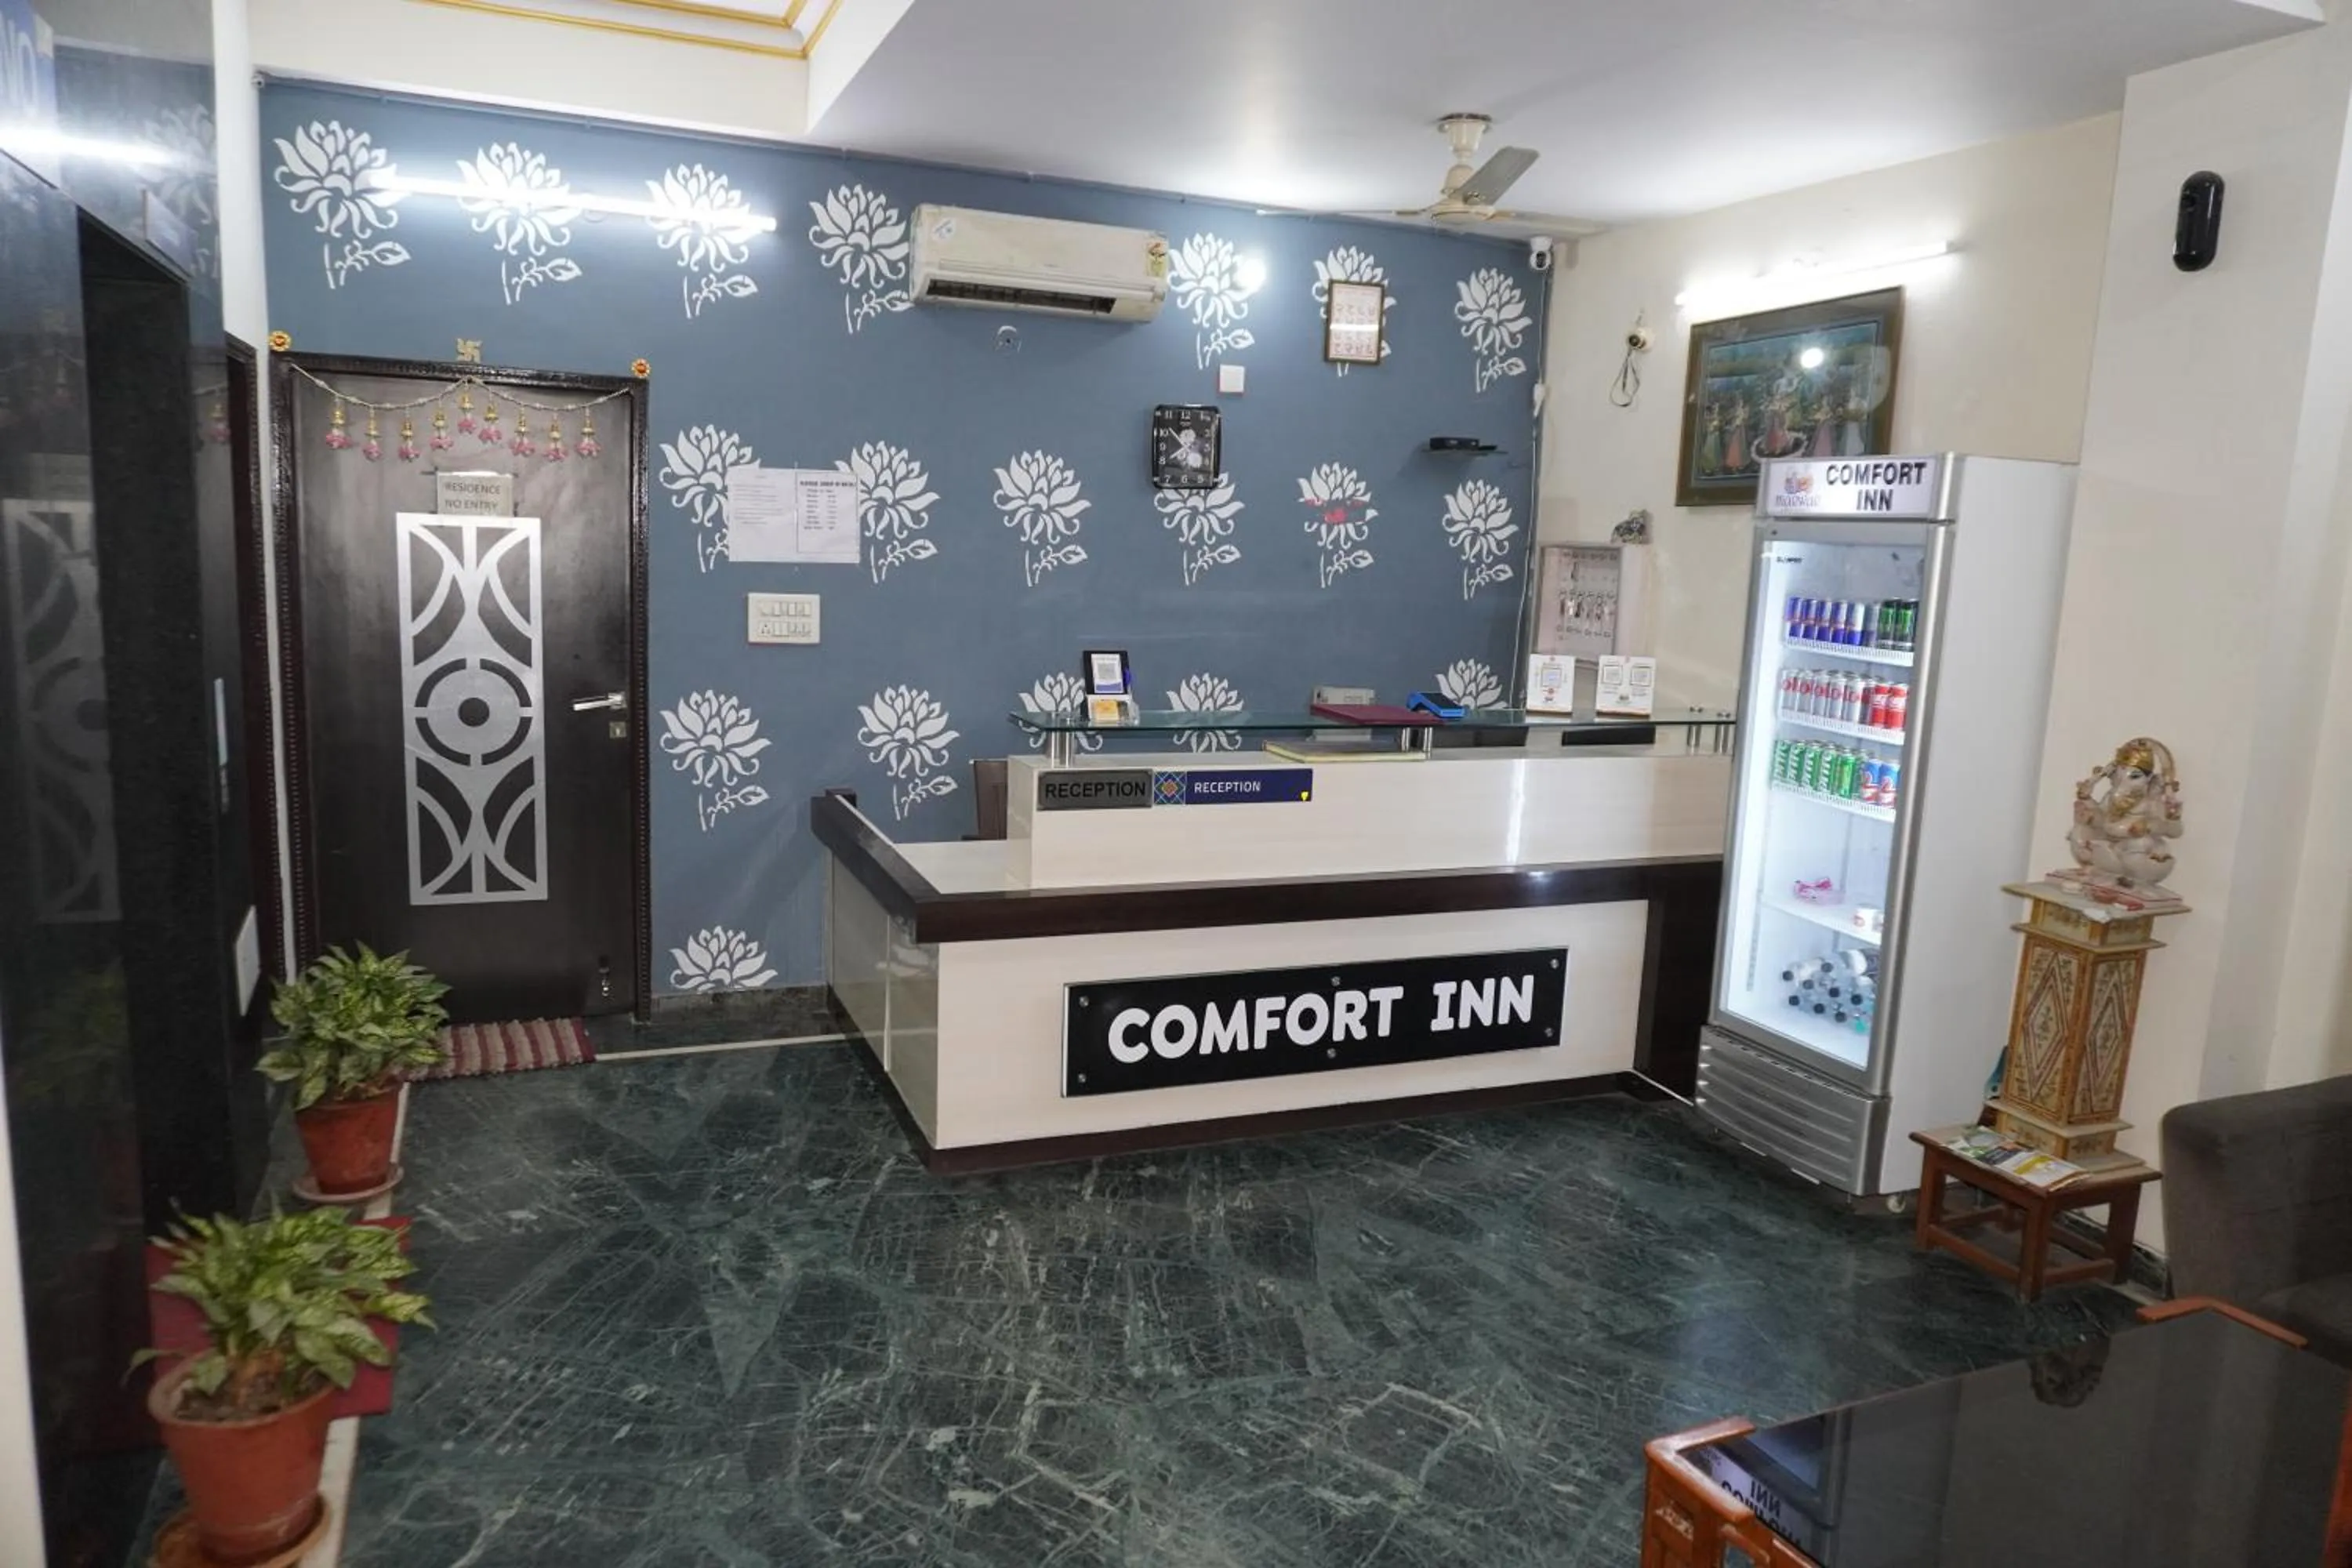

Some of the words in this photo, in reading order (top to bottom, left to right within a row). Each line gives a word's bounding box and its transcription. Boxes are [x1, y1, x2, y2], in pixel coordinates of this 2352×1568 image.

[1826, 462, 1927, 485] COMFORT
[444, 482, 501, 495] RESIDENCE
[445, 499, 462, 509] NO
[464, 500, 499, 510] ENTRY
[1856, 489, 1893, 511] INN
[1045, 781, 1146, 799] RECEPTION
[1194, 781, 1261, 793] RECEPTION
[1108, 985, 1403, 1064] COMFORT
[1430, 975, 1534, 1032] INN
